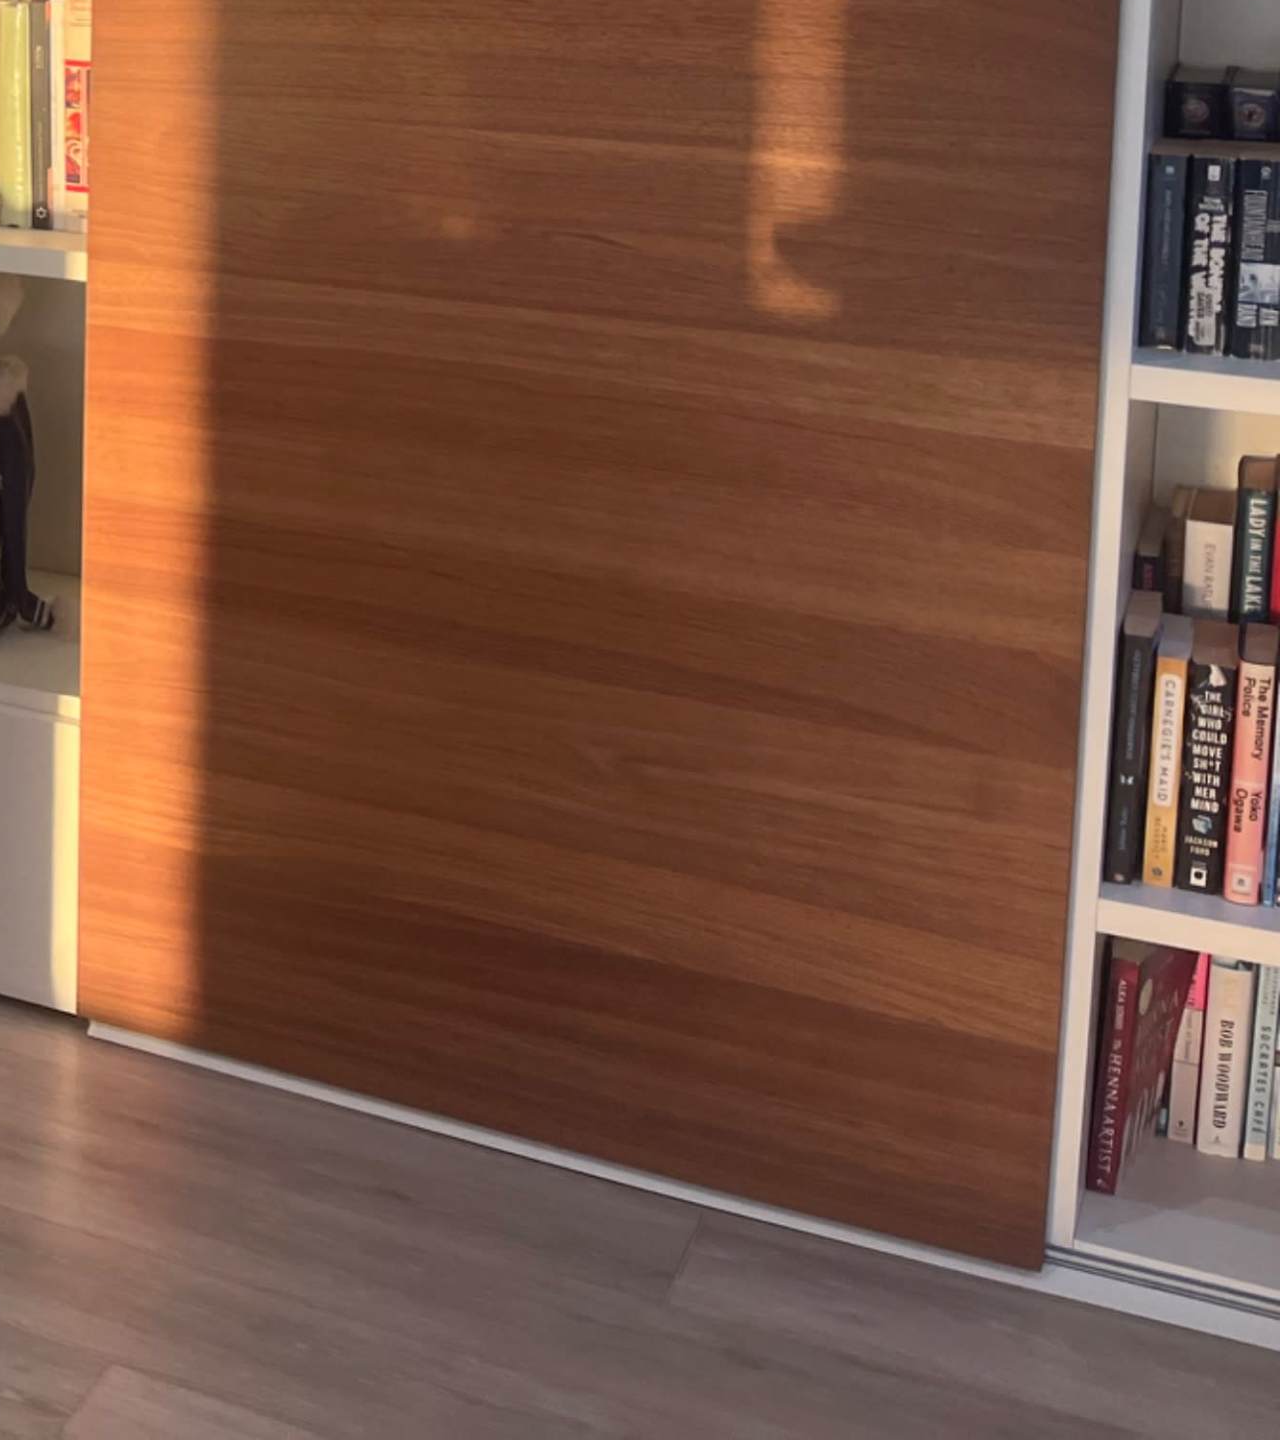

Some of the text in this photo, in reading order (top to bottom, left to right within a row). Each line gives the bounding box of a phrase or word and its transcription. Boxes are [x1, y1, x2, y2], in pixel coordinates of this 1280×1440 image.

[1194, 213, 1210, 234] OF
[1211, 214, 1228, 242] THE
[1192, 238, 1208, 266] THE
[1204, 544, 1216, 572] EVAN
[1244, 498, 1268, 613] LADY IN THE LAKE
[1205, 691, 1222, 702] THE
[1240, 677, 1256, 717] Police
[1198, 717, 1222, 730] WHO
[1252, 676, 1272, 760] The Memory
[1156, 680, 1176, 802] CARNEGIE'S MAID
[1192, 728, 1228, 745] COULD
[1192, 744, 1222, 759] MOVE
[1192, 771, 1220, 787] WITH
[1194, 786, 1216, 800] HER
[1190, 798, 1220, 814] MIND
[1231, 788, 1249, 832] Ogawa
[1248, 790, 1262, 822] Yoko
[1256, 1026, 1272, 1093] SOCRATES
[1212, 1020, 1236, 1129] BOB WOODWARD
[1097, 1053, 1122, 1174] HENNA ARTIST
[1252, 1100, 1266, 1134] CAFÉ
